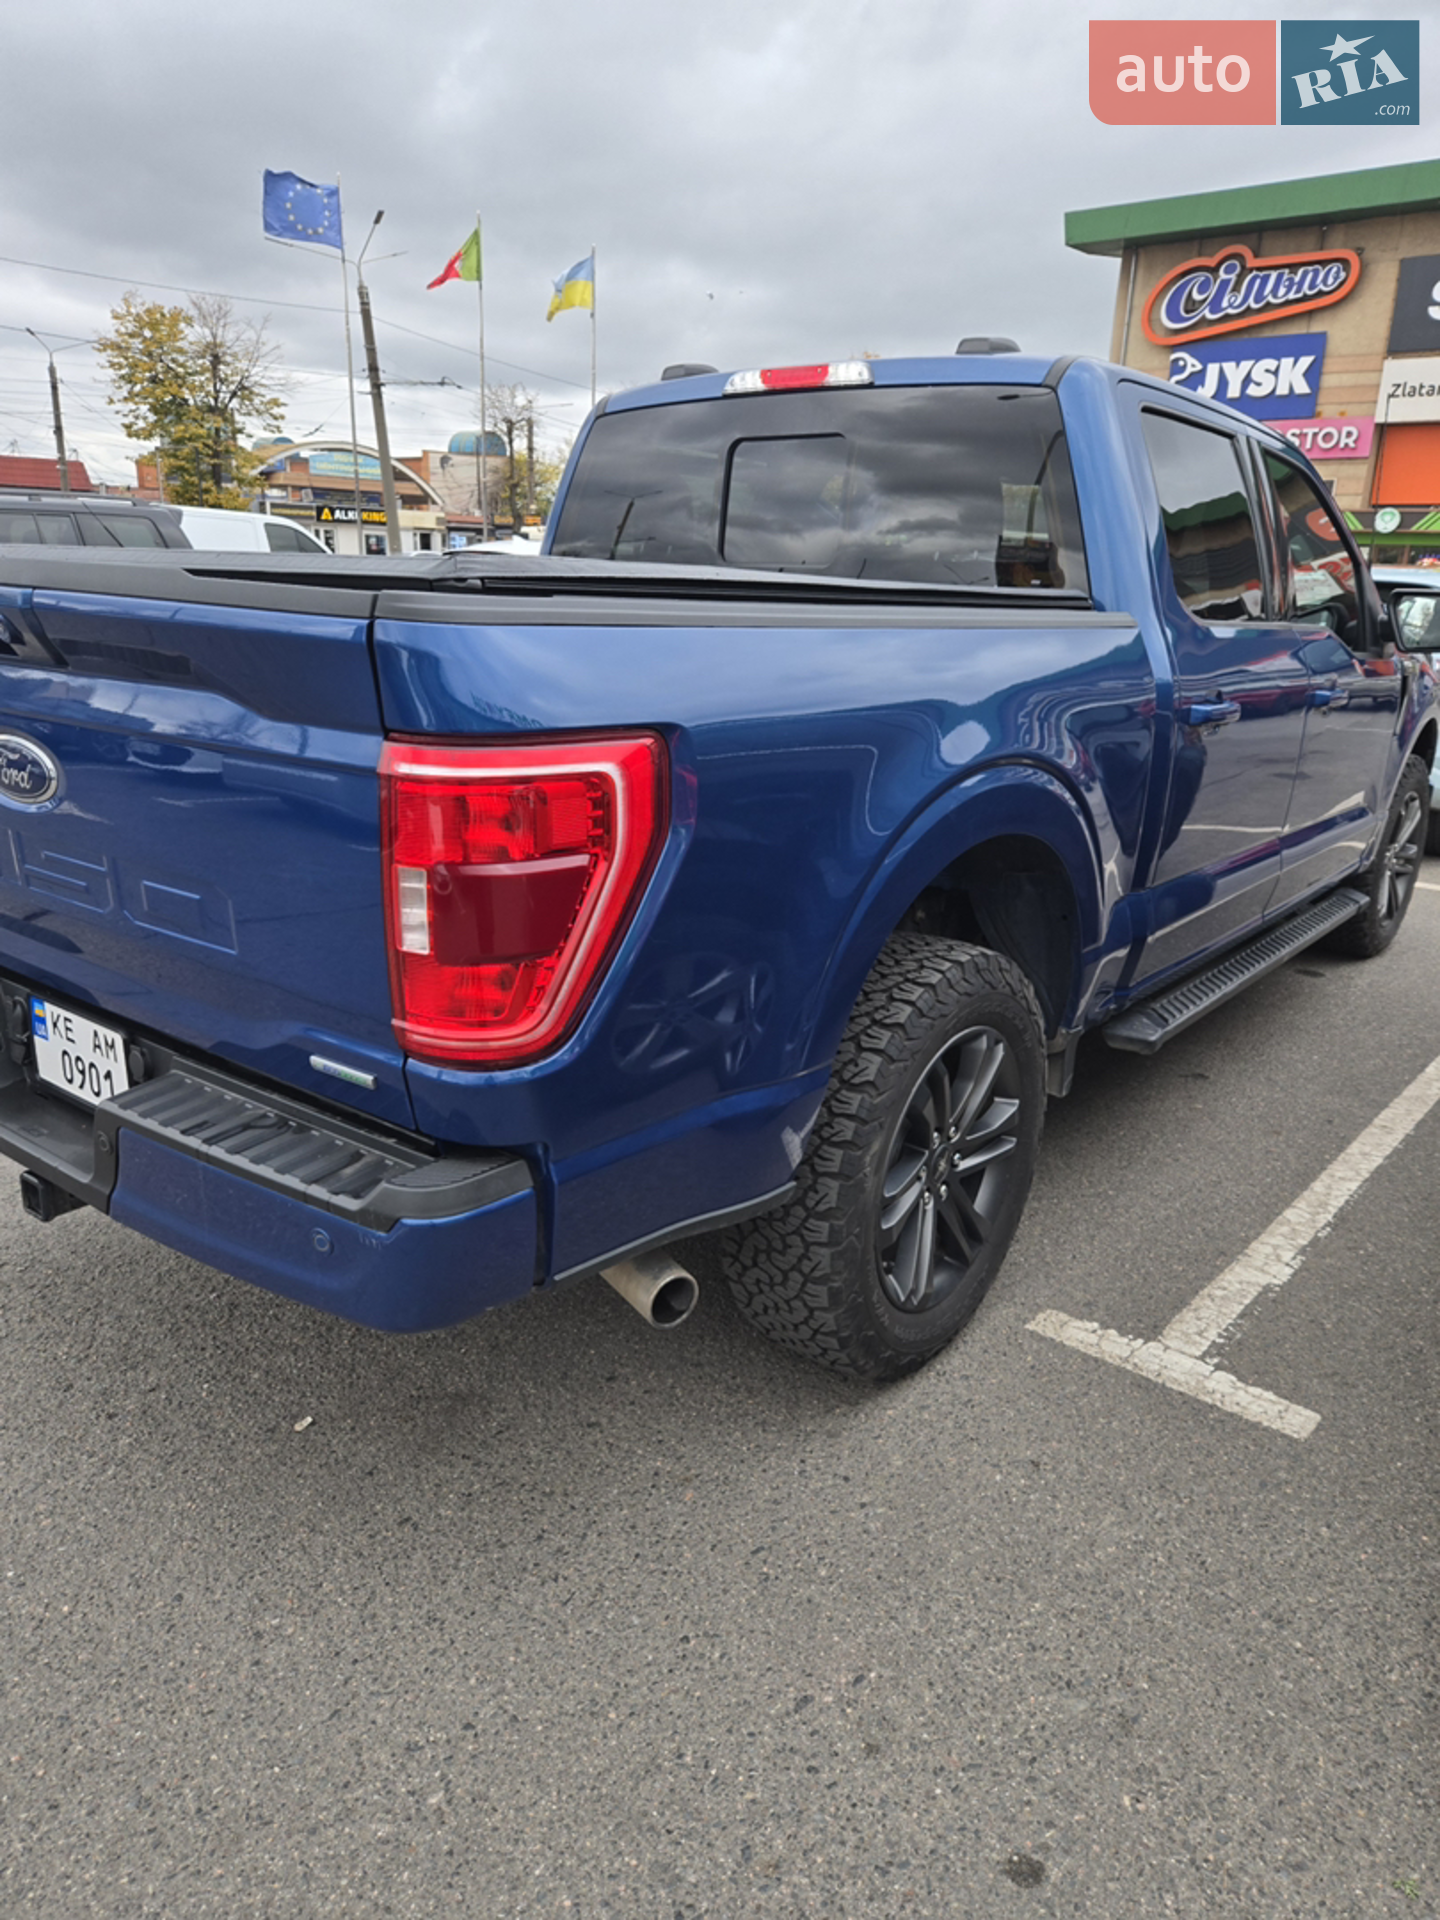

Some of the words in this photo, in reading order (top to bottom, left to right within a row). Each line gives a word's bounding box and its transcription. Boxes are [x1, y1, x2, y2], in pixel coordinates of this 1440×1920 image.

[1160, 259, 1346, 330] Сільпо
[1195, 355, 1316, 400] JYSK
[50, 1010, 76, 1045] KE
[92, 1028, 118, 1063] AM
[61, 1048, 115, 1098] 0901
